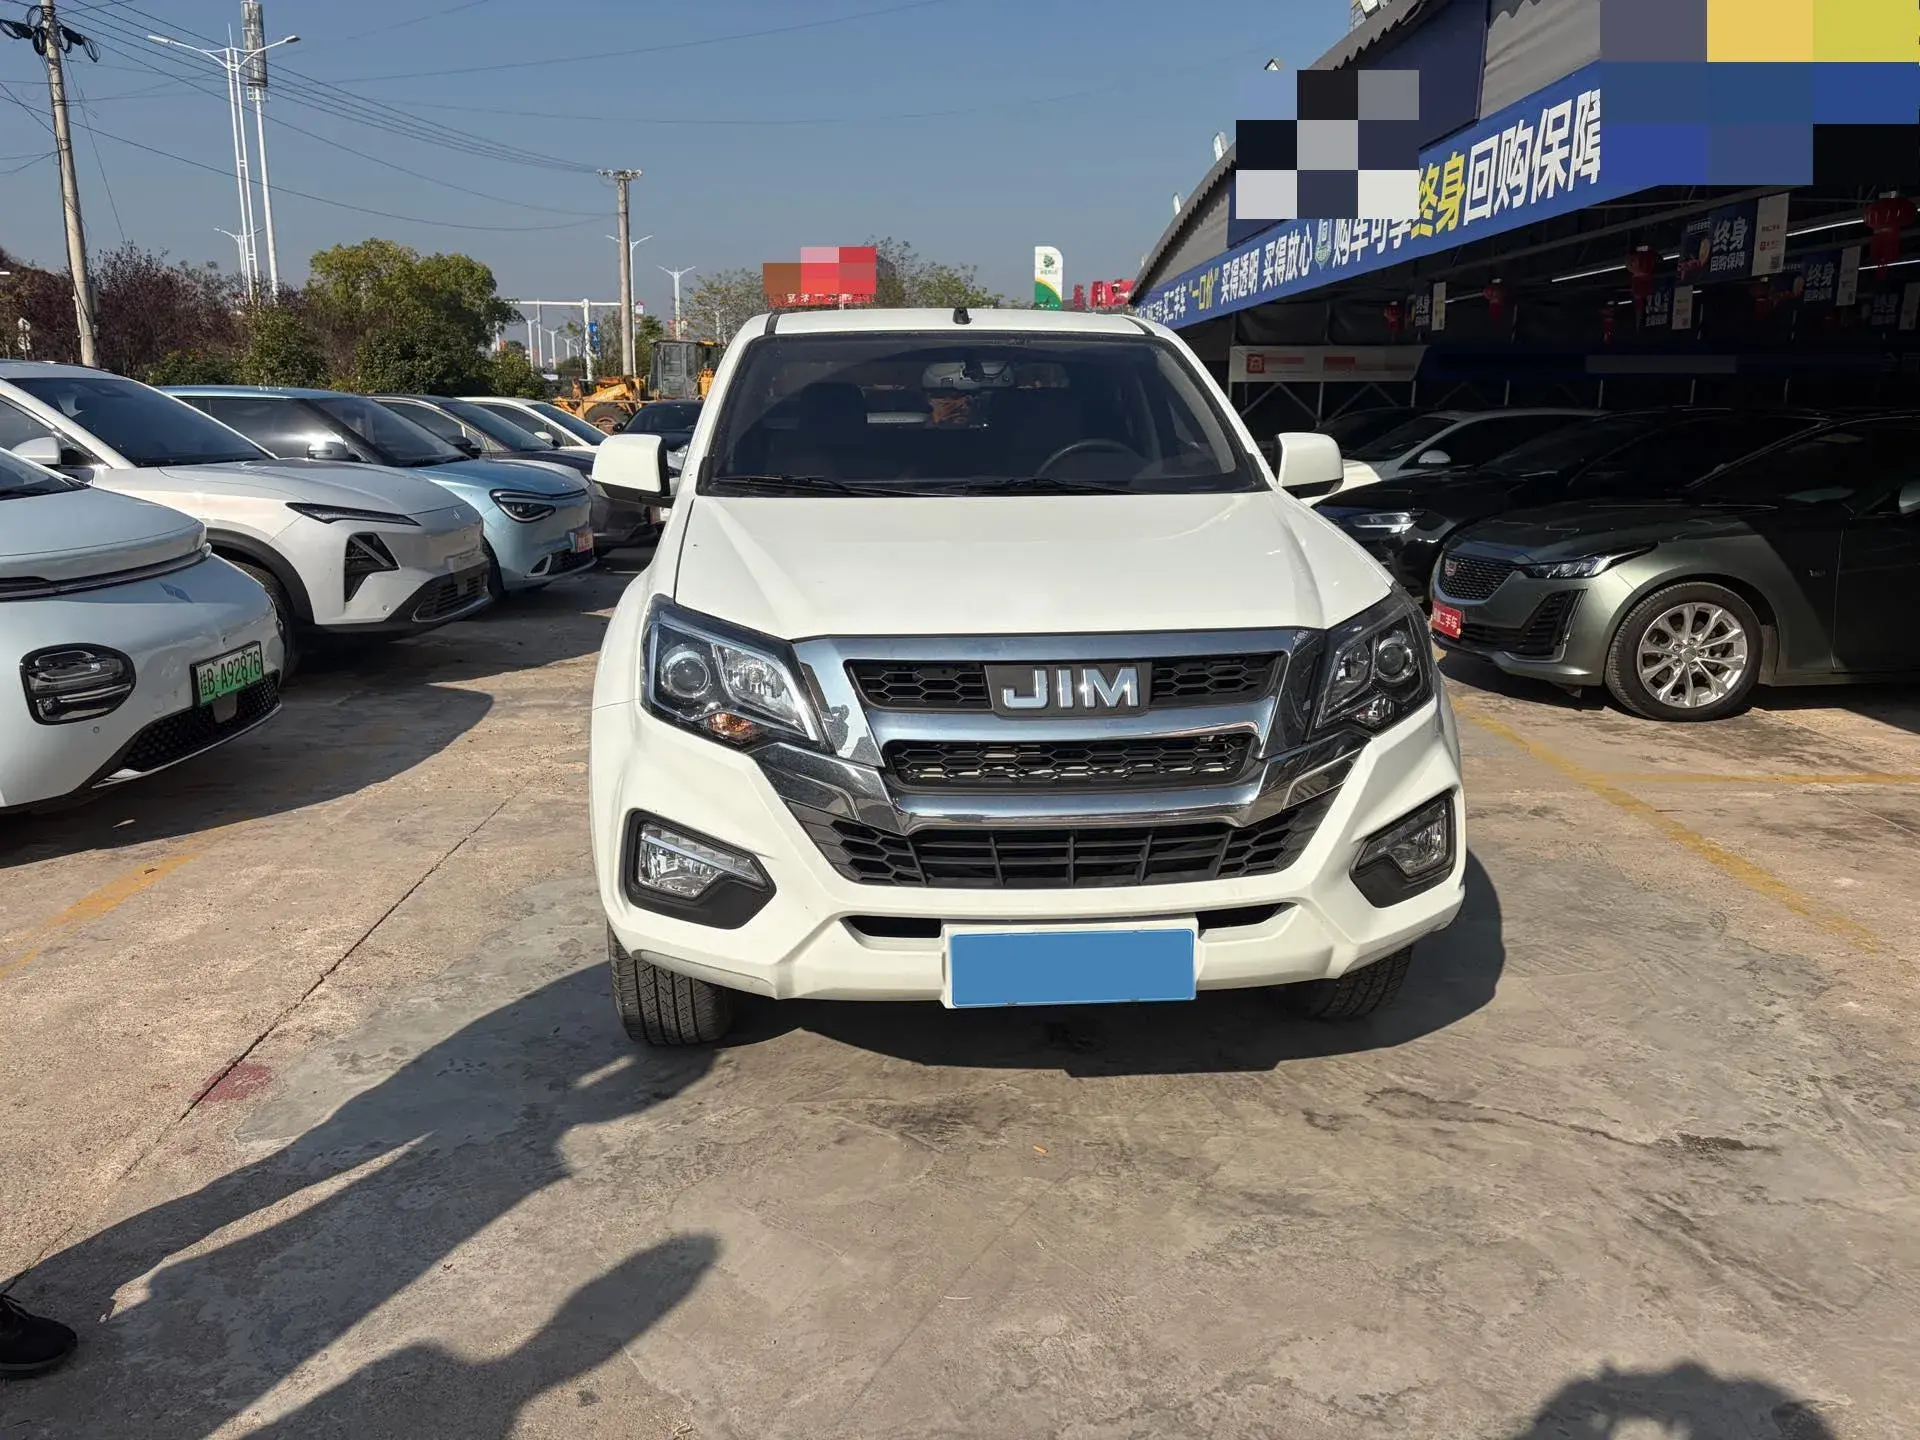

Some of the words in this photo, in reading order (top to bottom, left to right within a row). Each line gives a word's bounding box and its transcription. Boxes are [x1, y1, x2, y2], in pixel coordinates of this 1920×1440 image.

[1712, 215, 1748, 252] 终身
[1262, 223, 1313, 292] 买得放心
[1710, 250, 1746, 273] 回购保障
[1003, 667, 1139, 708] JIM
